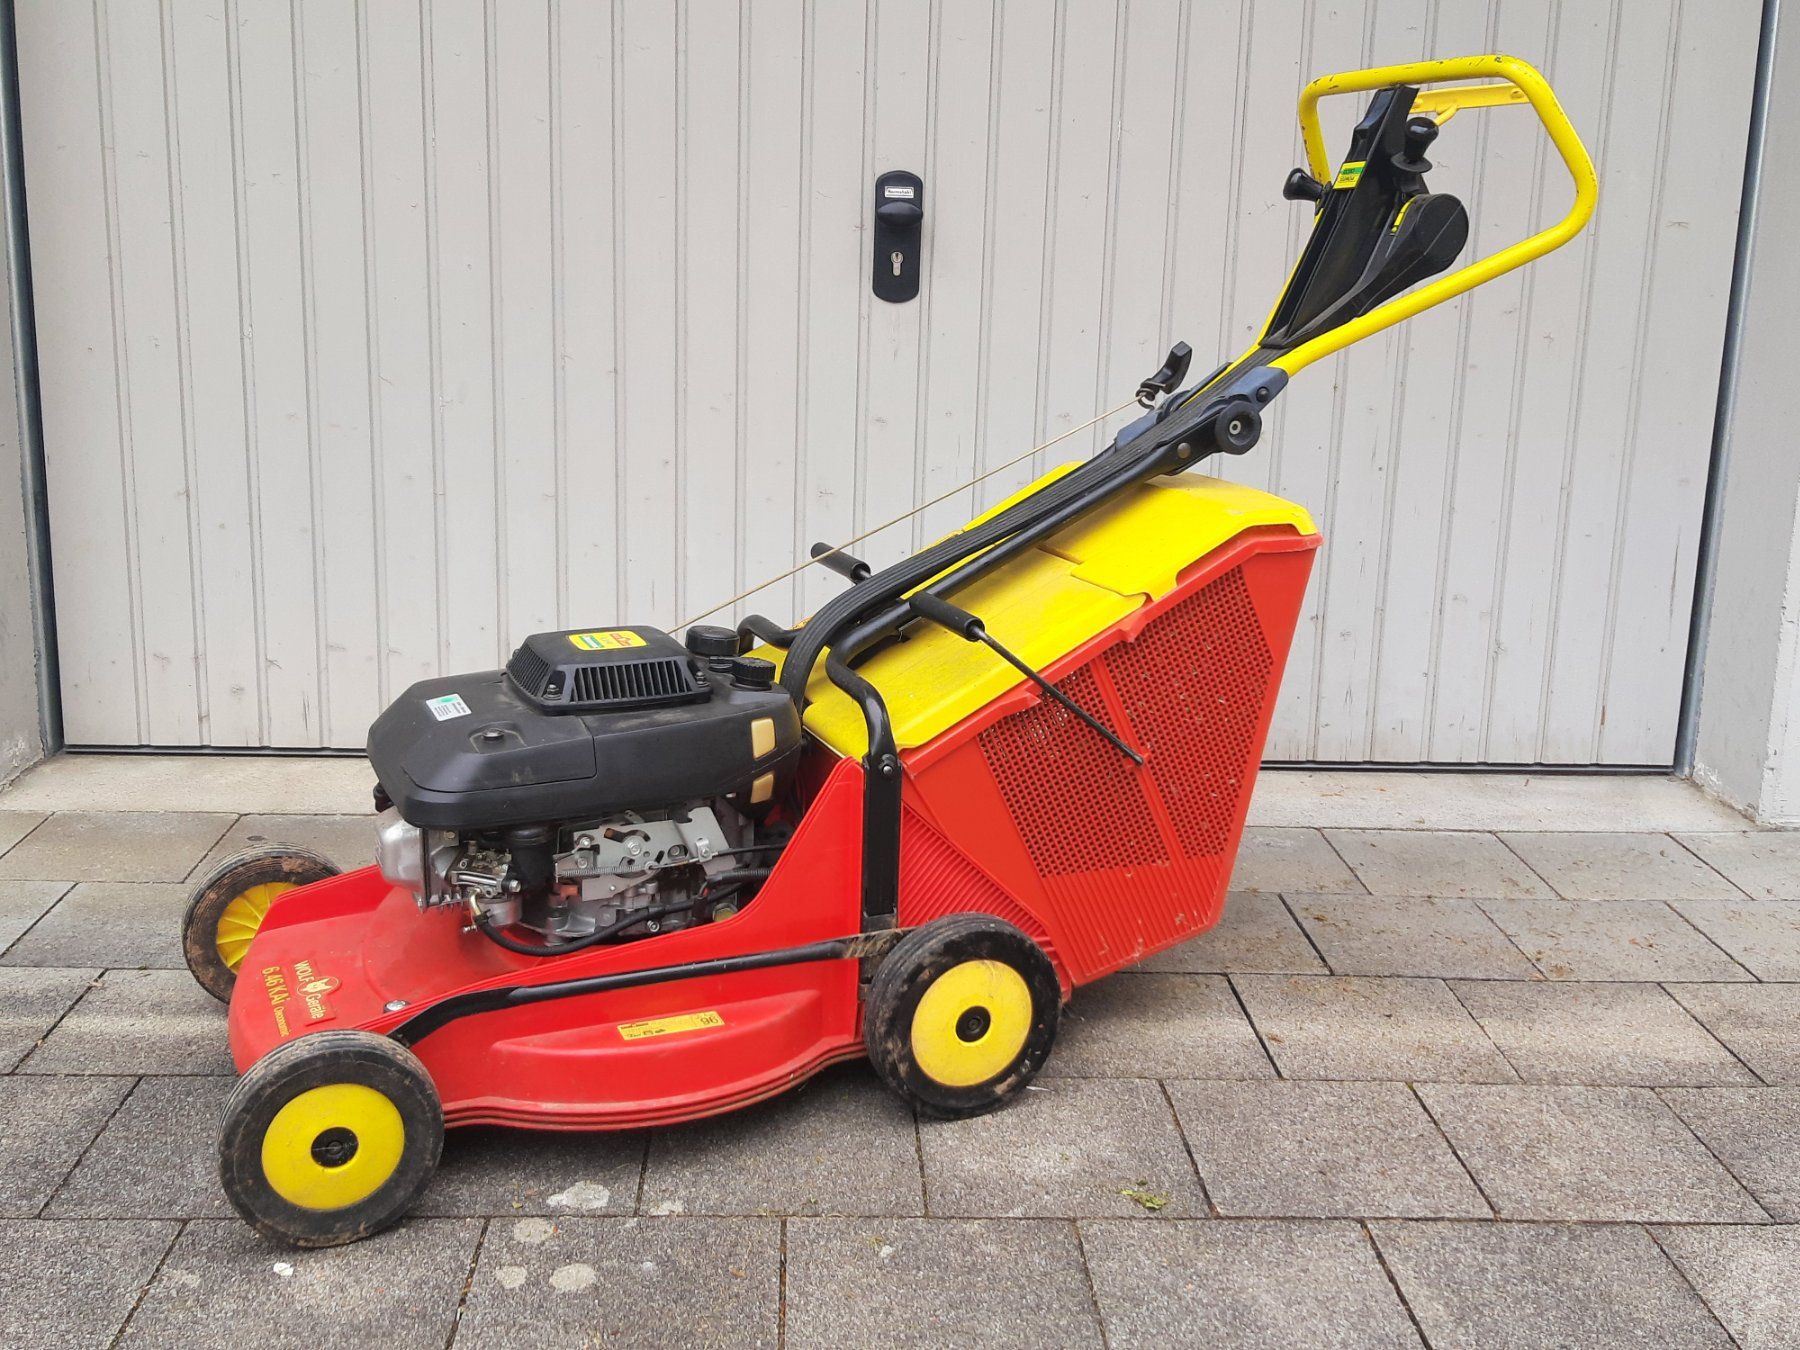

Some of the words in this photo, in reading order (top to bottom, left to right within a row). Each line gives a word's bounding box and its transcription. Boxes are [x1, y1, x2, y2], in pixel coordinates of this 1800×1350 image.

[261, 966, 284, 987] 6.46
[293, 959, 315, 983] WOLF
[305, 993, 327, 1019] Geräte
